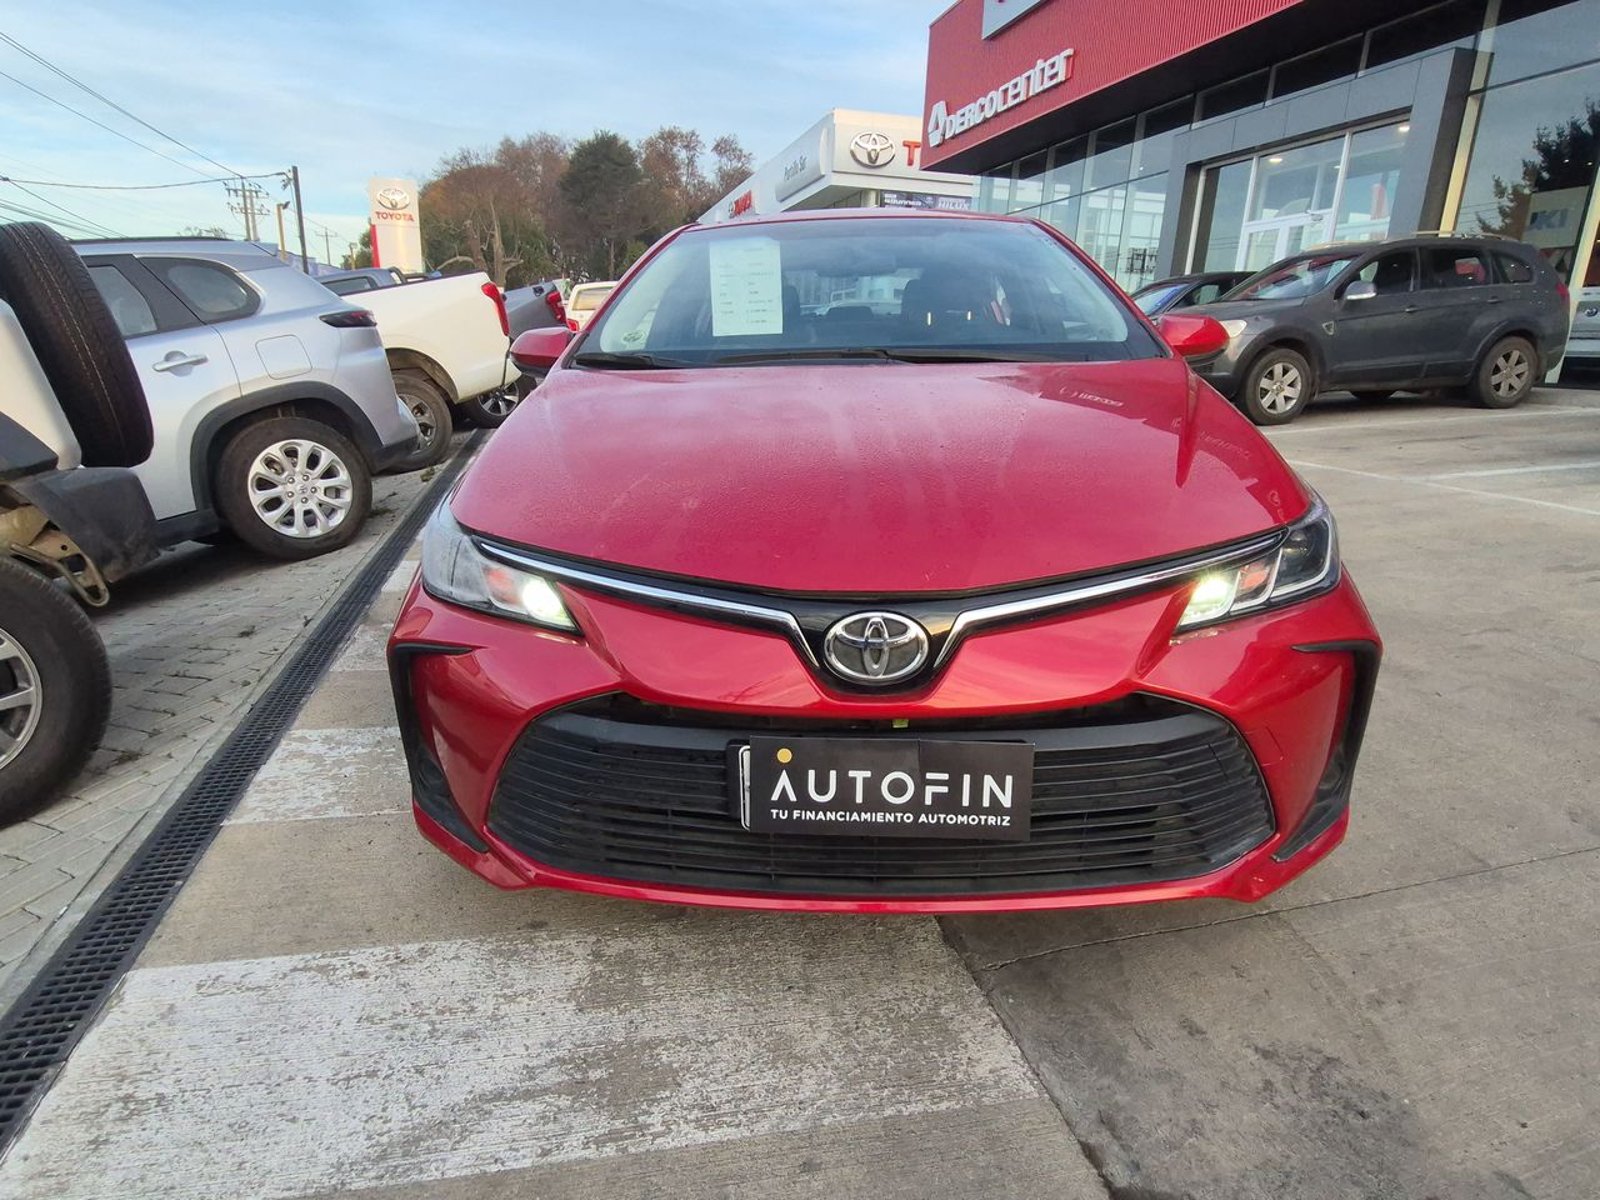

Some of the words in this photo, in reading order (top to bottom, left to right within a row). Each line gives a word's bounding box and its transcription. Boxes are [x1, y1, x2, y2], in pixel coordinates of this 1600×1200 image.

[375, 211, 415, 222] TOYOTA
[771, 769, 1013, 808] AUTOFIN
[771, 809, 788, 820] TU
[793, 810, 914, 824] FINANCIAMIENTO
[918, 813, 1011, 827] AUTOMOTRIZ
